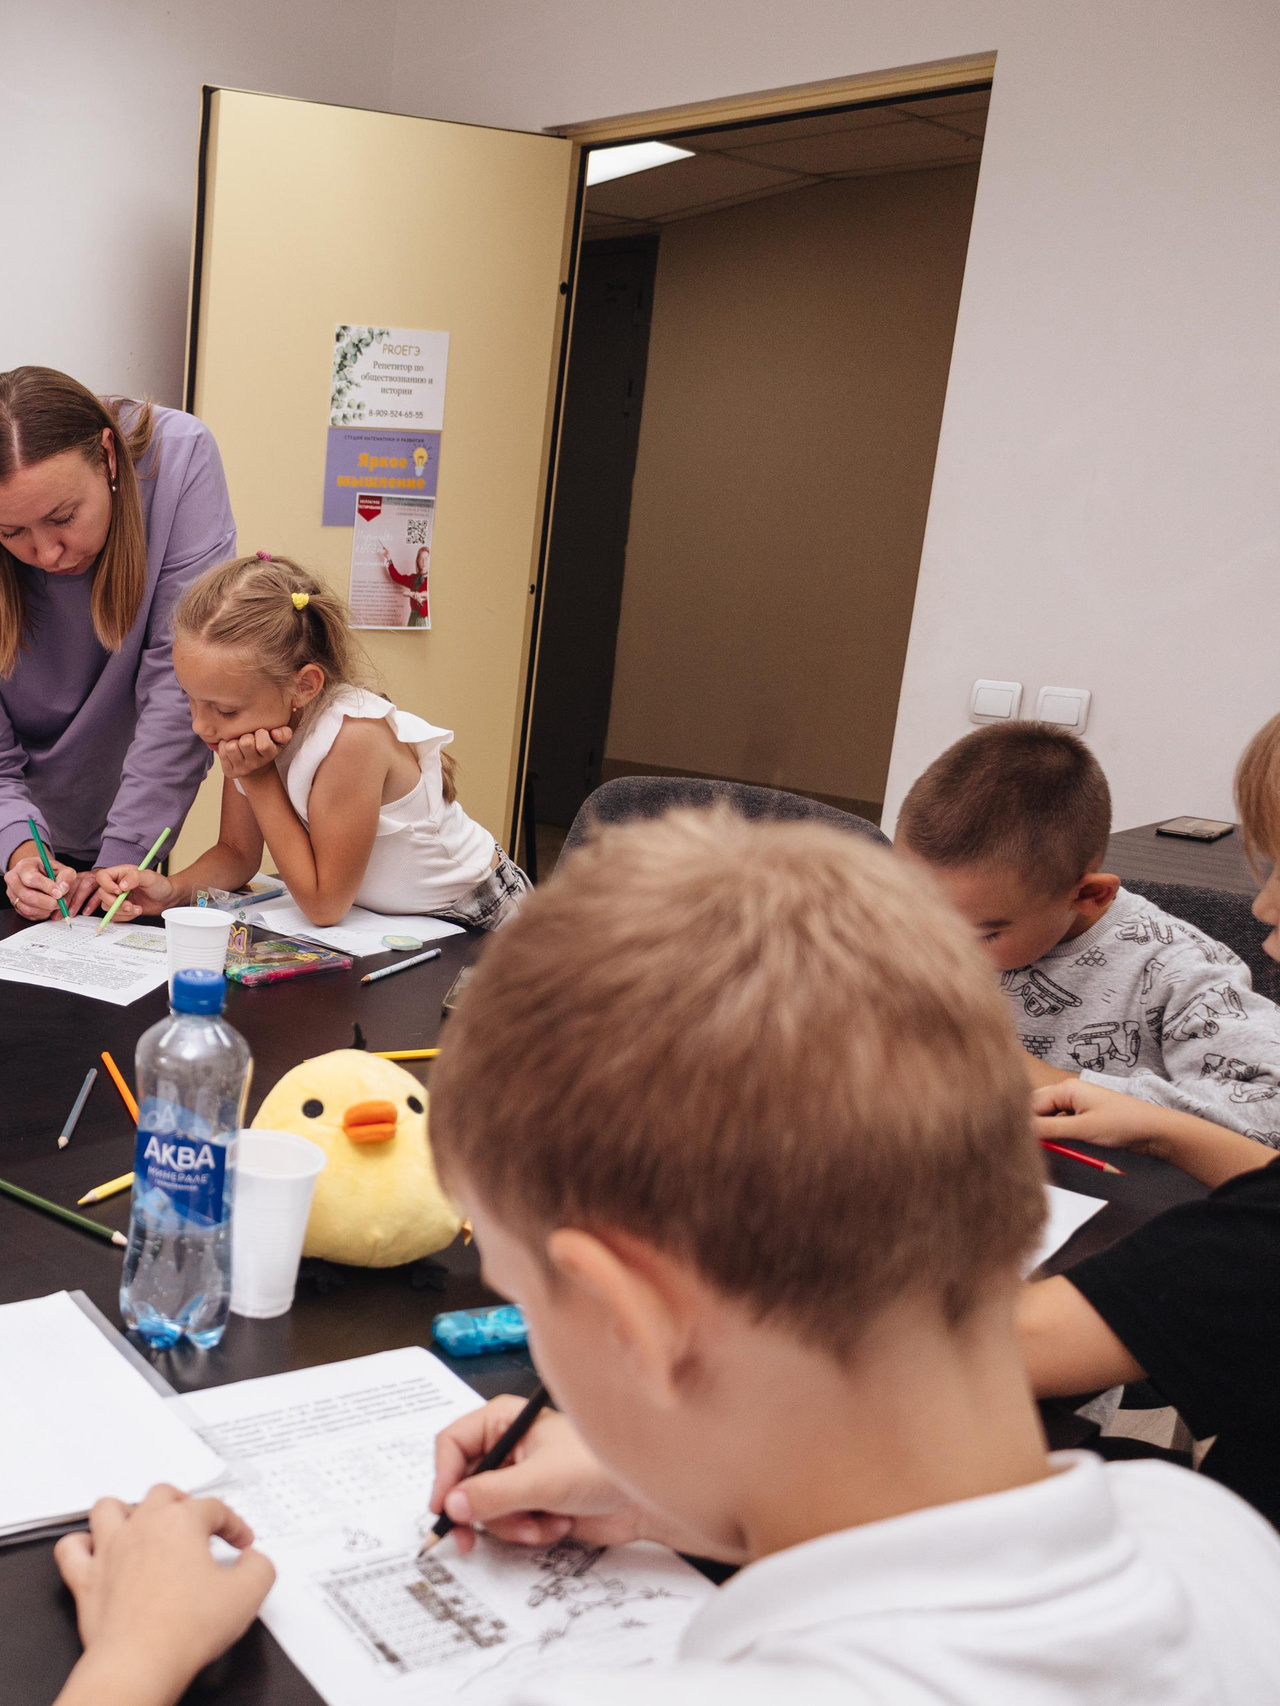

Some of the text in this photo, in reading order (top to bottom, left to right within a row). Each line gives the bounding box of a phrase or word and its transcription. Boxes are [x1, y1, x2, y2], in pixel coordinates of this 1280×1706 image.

[372, 360, 413, 374] Репетитор
[360, 371, 427, 385] обществознанию
[380, 386, 413, 397] истории
[358, 452, 409, 472] Яркое
[144, 1135, 216, 1172] АКВА
